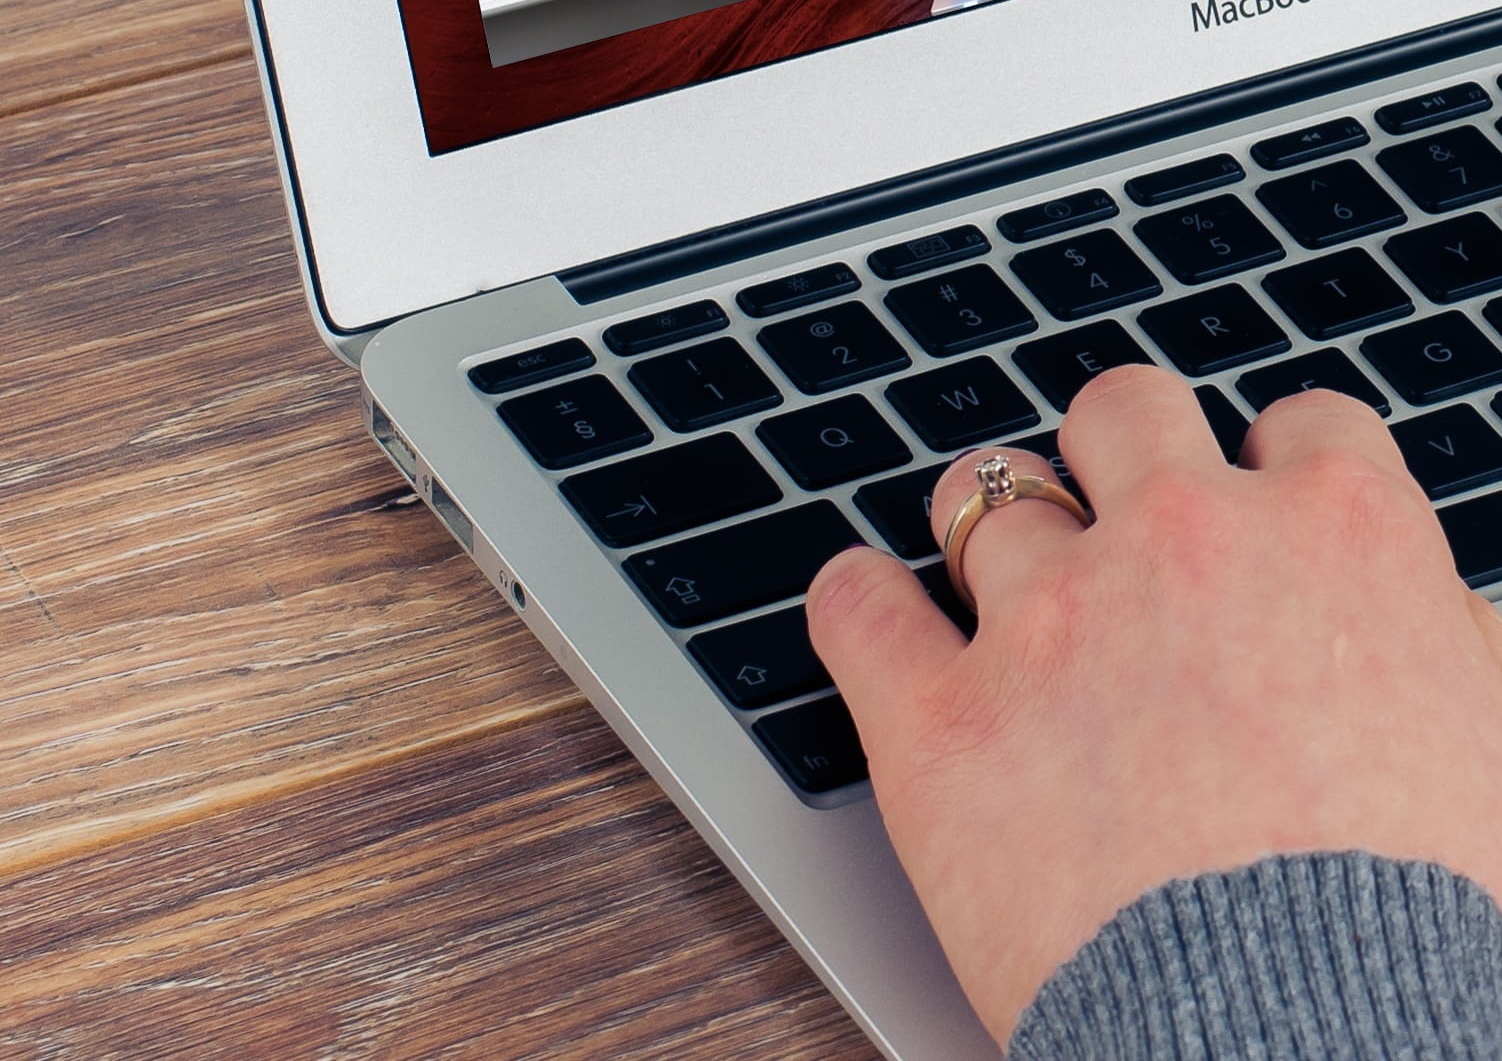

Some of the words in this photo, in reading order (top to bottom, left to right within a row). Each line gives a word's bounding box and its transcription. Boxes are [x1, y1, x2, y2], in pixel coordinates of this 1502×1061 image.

[1428, 144, 1455, 162] &
[1447, 166, 1468, 185] 7
[1333, 202, 1353, 220] 6
[1181, 213, 1214, 232] %
[1209, 236, 1232, 255] 5
[1444, 242, 1469, 262] Y
[1063, 248, 1087, 267] $
[1090, 272, 1109, 289] 4
[1322, 277, 1347, 299] T
[939, 283, 958, 303] #
[958, 308, 983, 327] 3
[1200, 316, 1230, 337] R
[809, 321, 835, 338] @
[517, 353, 547, 368] esc
[831, 346, 858, 365] 2
[1075, 351, 1103, 372] E
[1423, 342, 1453, 363] G
[703, 383, 724, 400] 1
[940, 385, 980, 411] W
[573, 420, 596, 439] §
[819, 427, 855, 448] Q
[1427, 435, 1455, 457] V
[802, 755, 829, 770] fn
